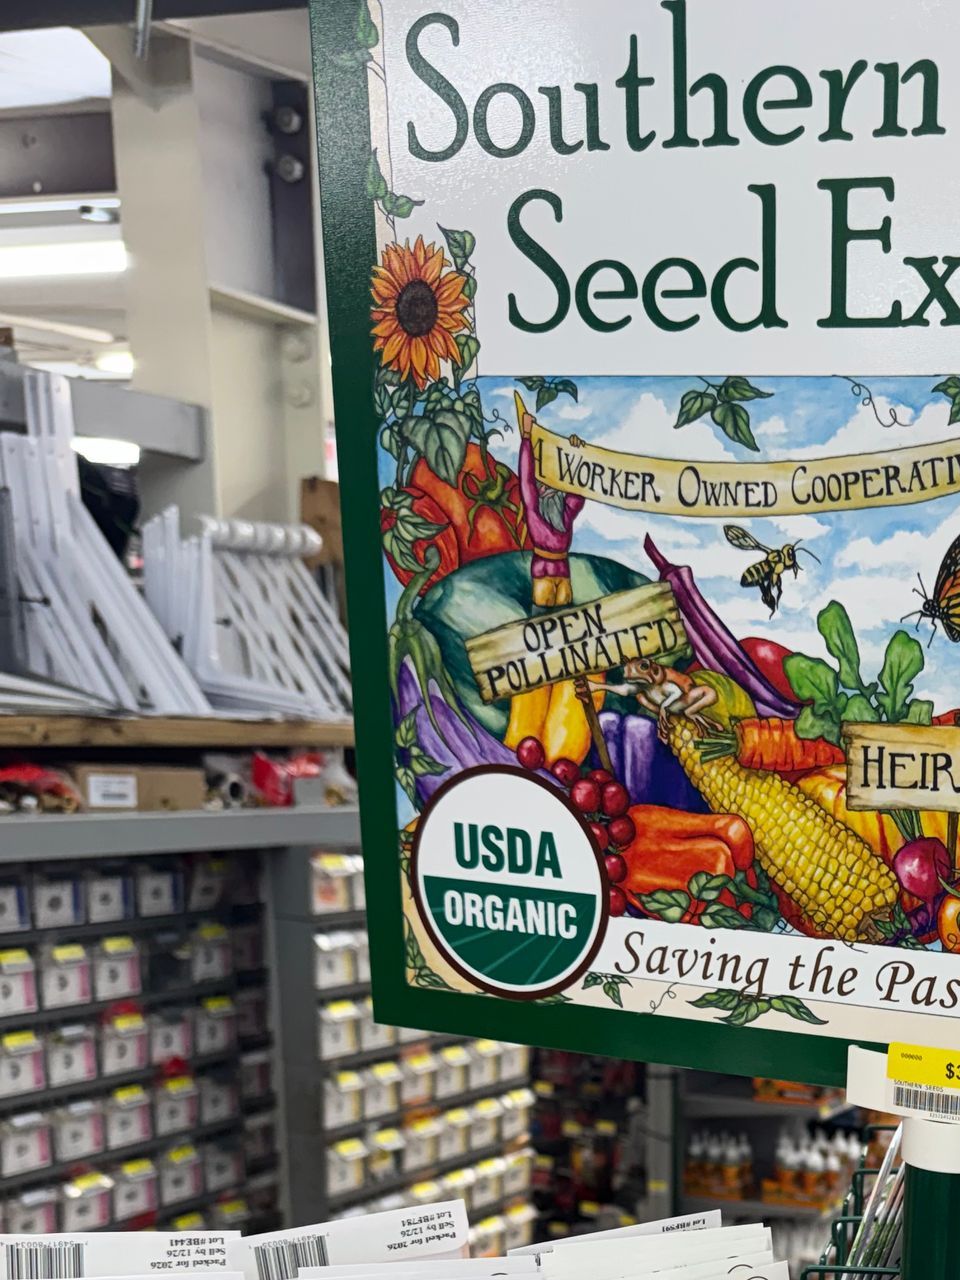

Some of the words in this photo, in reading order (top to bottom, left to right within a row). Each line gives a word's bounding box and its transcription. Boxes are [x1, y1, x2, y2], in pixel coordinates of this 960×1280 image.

[406, 0, 946, 162] Southern
[506, 188, 790, 333] Seed
[523, 603, 606, 651] OPEN
[486, 618, 678, 698] POLLINATED
[453, 823, 562, 879] USDA
[444, 889, 578, 939] ORGANIC
[614, 931, 771, 1000] Saving
[788, 946, 857, 996] the
[894, 1079, 922, 1089] SOUTHERN
[925, 1084, 943, 1092] SEEDS
[170, 1238, 206, 1246] #BE441
[209, 1237, 224, 1245] Lot
[166, 1249, 191, 1258] 12/26
[195, 1248, 205, 1257] by
[208, 1247, 226, 1256] Sell
[150, 1260, 172, 1269] 2026
[177, 1260, 192, 1269] for
[196, 1258, 226, 1269] Packed
